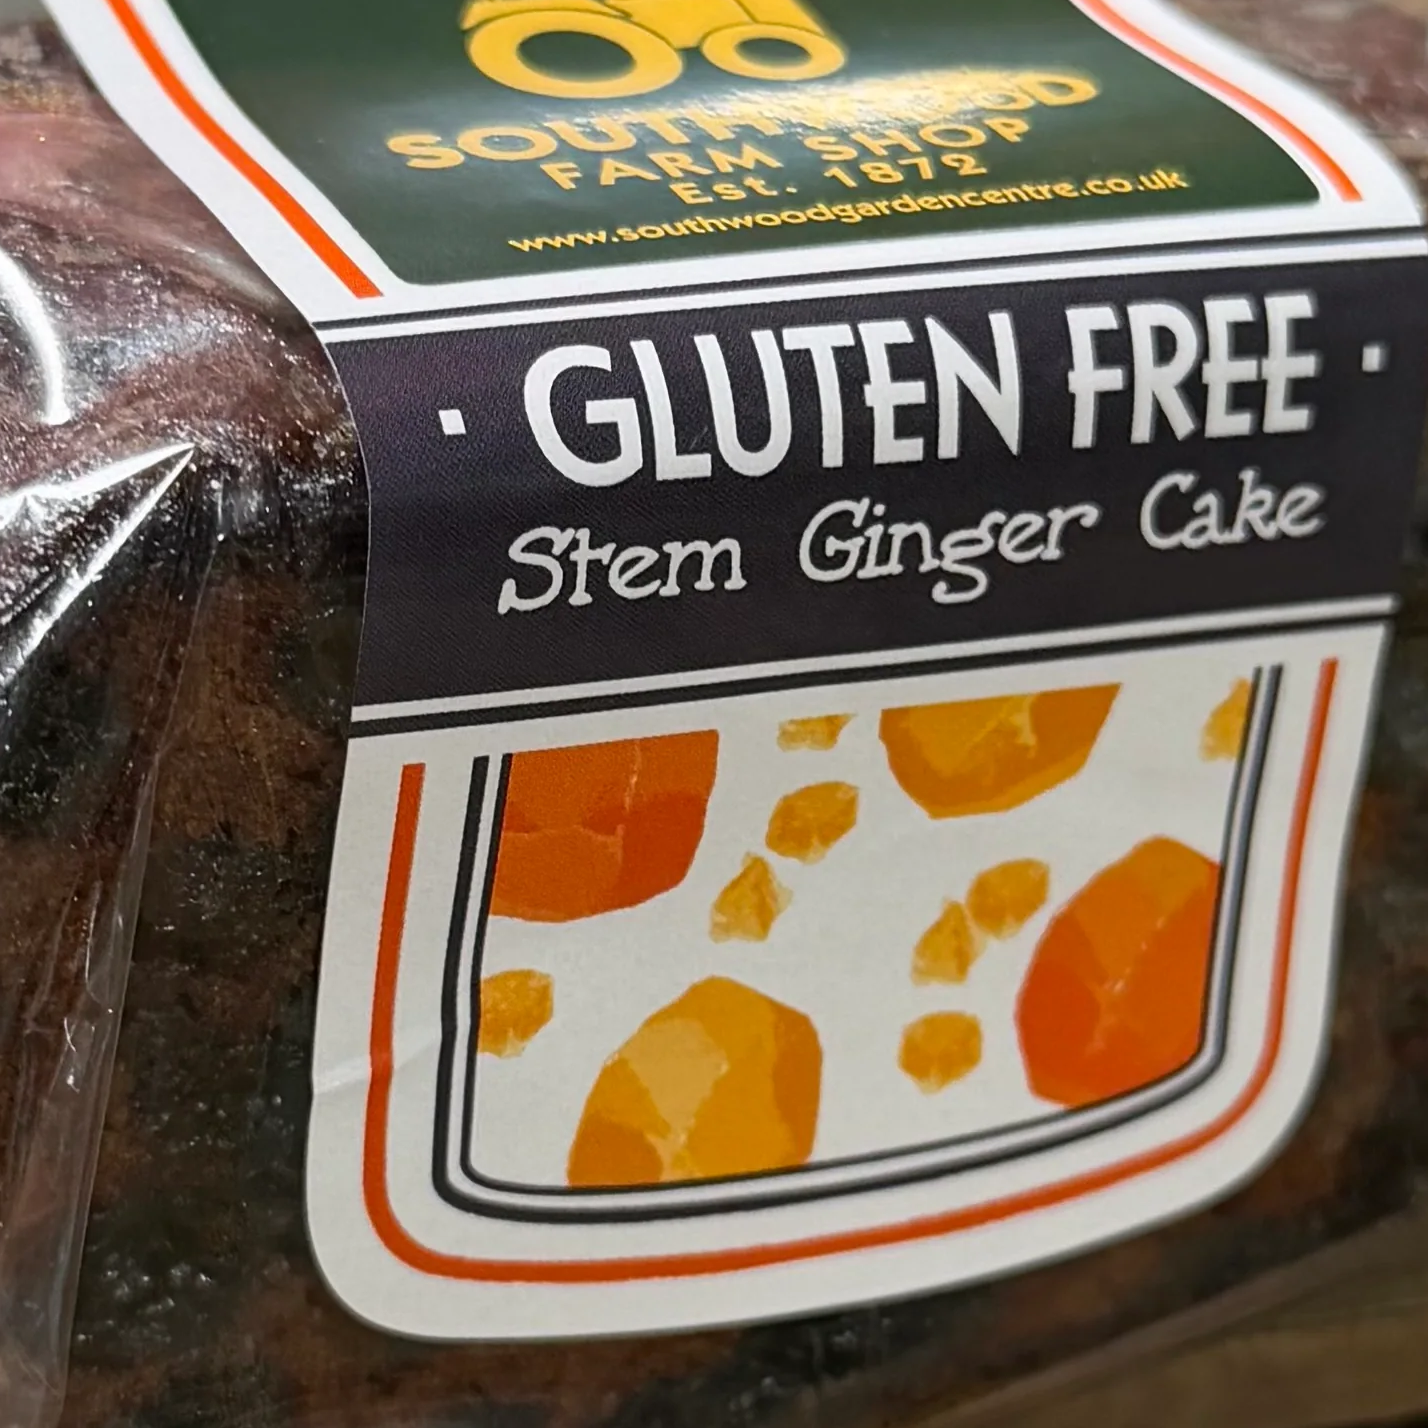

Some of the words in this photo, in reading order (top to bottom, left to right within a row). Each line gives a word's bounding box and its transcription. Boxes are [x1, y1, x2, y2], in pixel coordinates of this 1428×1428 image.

[386, 70, 1100, 172] SOUTHOD
[540, 143, 783, 191] FARM
[802, 117, 1032, 163] SHOP
[507, 168, 1191, 254] www.southwoodgardencentre.co.uk
[669, 175, 799, 206] Est.
[823, 152, 988, 189] 1872
[522, 310, 1022, 489] GLUTEN
[1064, 293, 1318, 450] FREE
[496, 524, 748, 616] Stem
[798, 496, 1100, 606] Ginger
[1138, 467, 1329, 551] Cake
